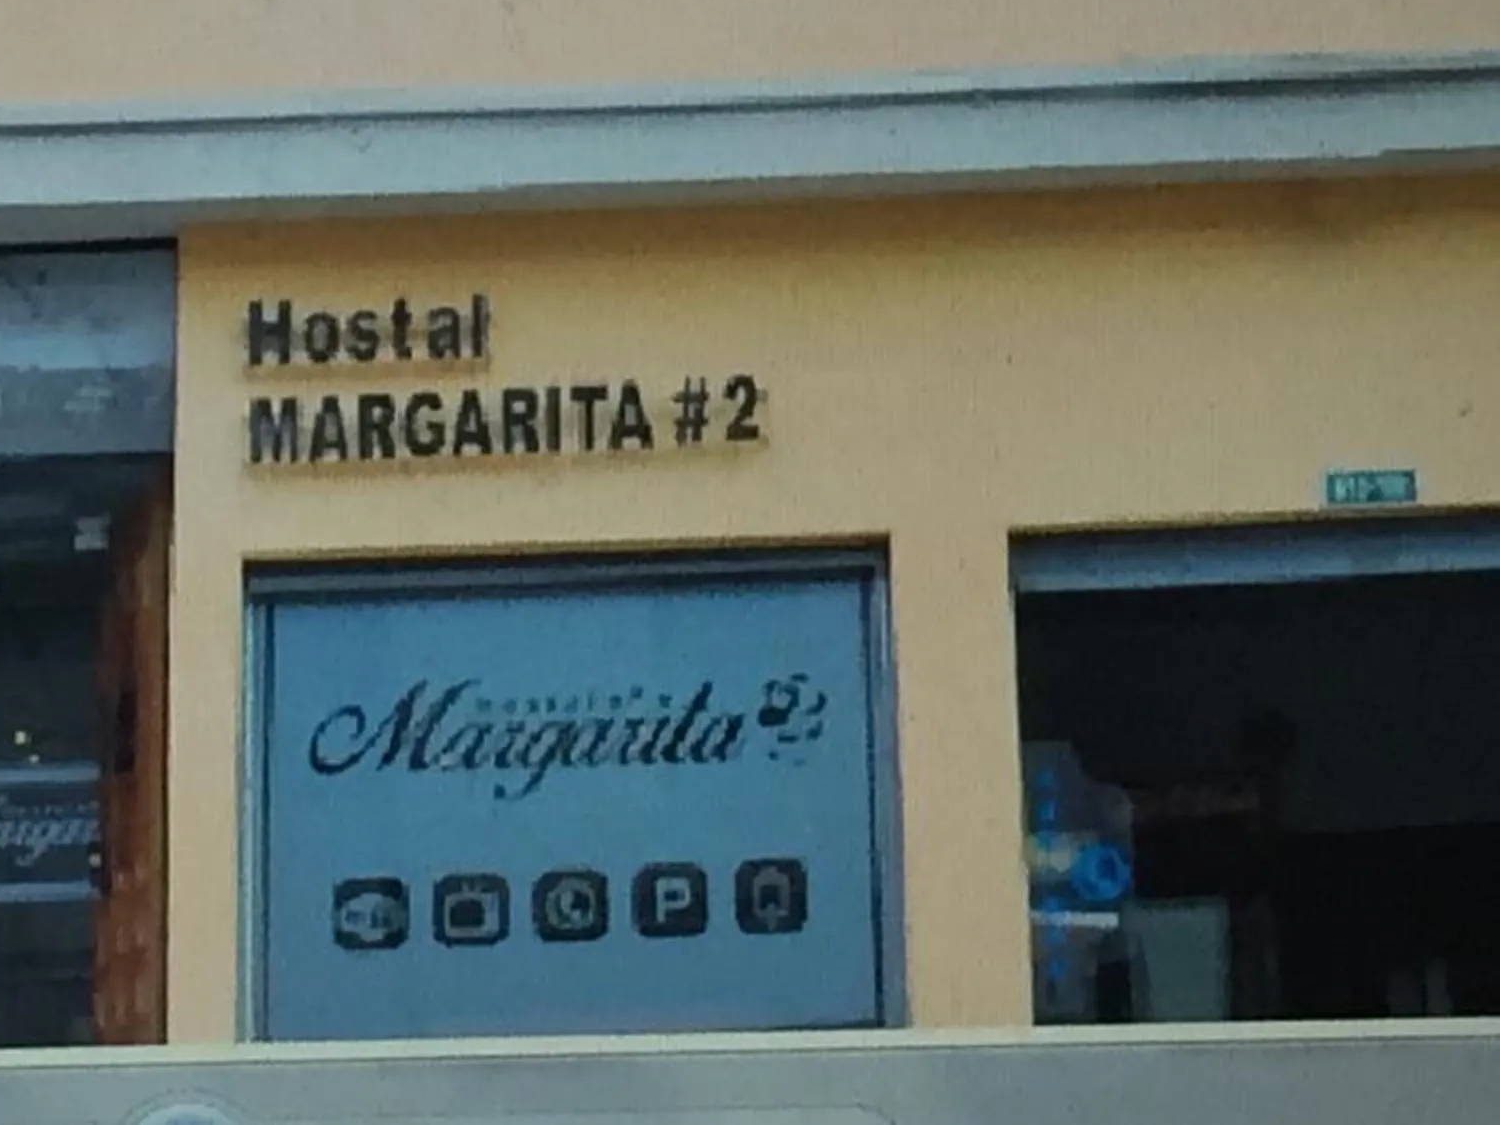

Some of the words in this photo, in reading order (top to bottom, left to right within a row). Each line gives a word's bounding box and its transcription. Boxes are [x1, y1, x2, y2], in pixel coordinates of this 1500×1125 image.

[248, 293, 487, 366] Hostal
[248, 379, 654, 463] MARGARITA
[308, 678, 745, 801] Margarita
